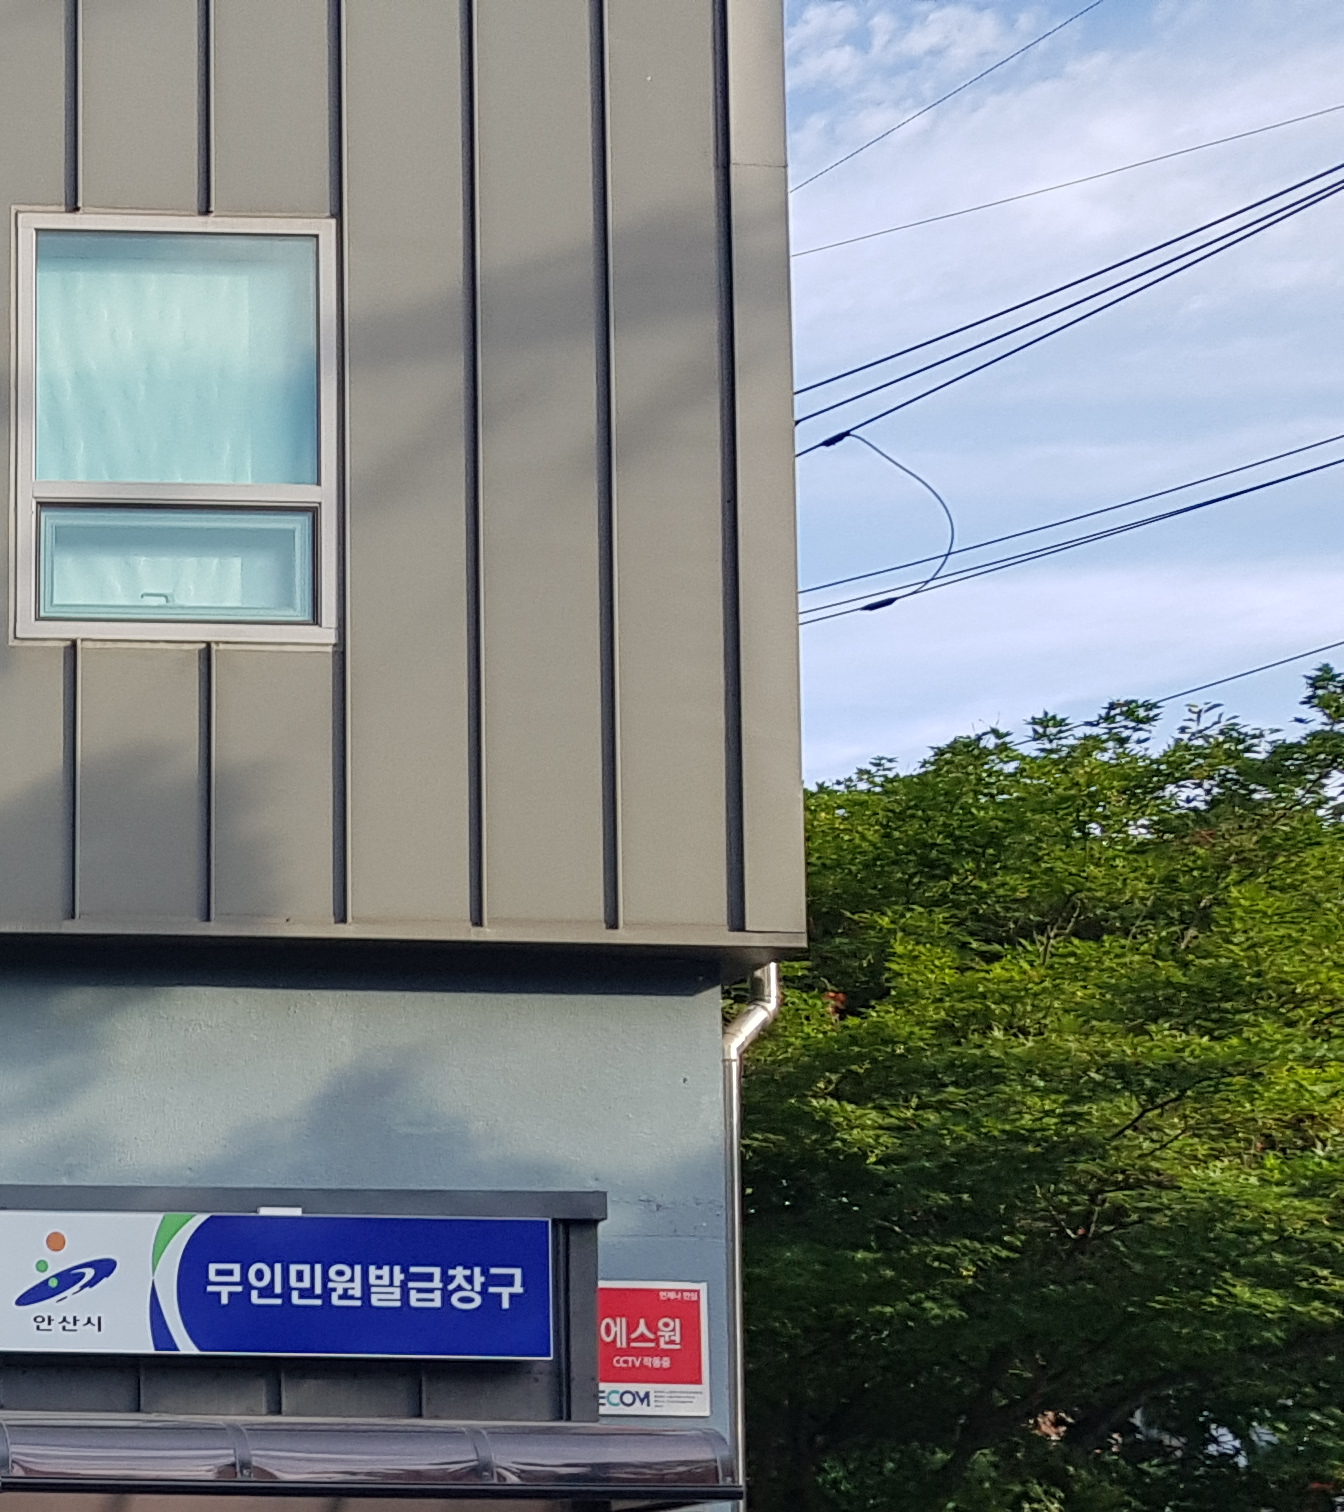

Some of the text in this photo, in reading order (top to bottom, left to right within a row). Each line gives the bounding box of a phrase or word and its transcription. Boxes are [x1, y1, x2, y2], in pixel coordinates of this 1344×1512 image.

[206, 1262, 524, 1310] 무인민원발급창구
[33, 1315, 101, 1332] 안산시
[600, 1316, 682, 1350] 에스원
[612, 1355, 642, 1368] CCTV
